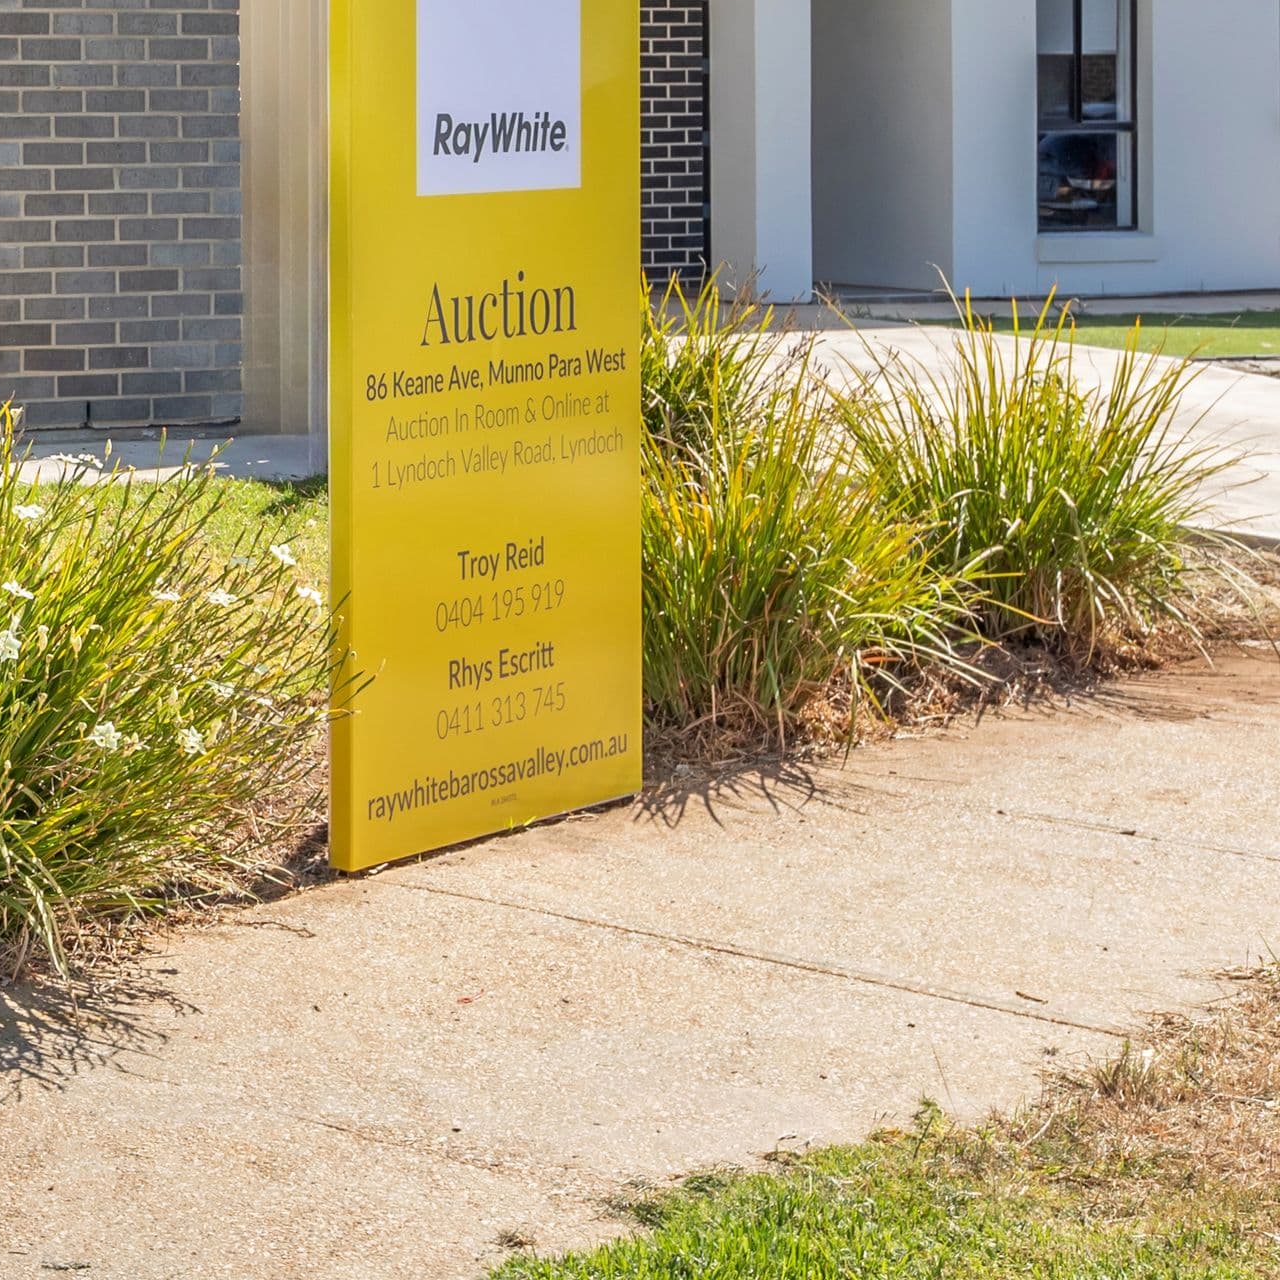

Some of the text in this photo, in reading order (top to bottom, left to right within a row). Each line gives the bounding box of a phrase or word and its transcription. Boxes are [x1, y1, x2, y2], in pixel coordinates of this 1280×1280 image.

[433, 112, 566, 163] RayWhite
[421, 271, 577, 346] Auction
[366, 347, 625, 401] 86 Keane Ave, Munno Para West
[386, 390, 609, 443] Auction In Room & Online at
[372, 427, 623, 490] 1 Lyndoch Valley Road, Lyndoch
[458, 536, 544, 580] Troy Reid
[435, 579, 565, 632] 0404 195 919
[449, 641, 554, 690] Rhys Escritt
[437, 682, 565, 740] 0411 313 745
[368, 733, 627, 822] raywhitebarossavalley.com.au
